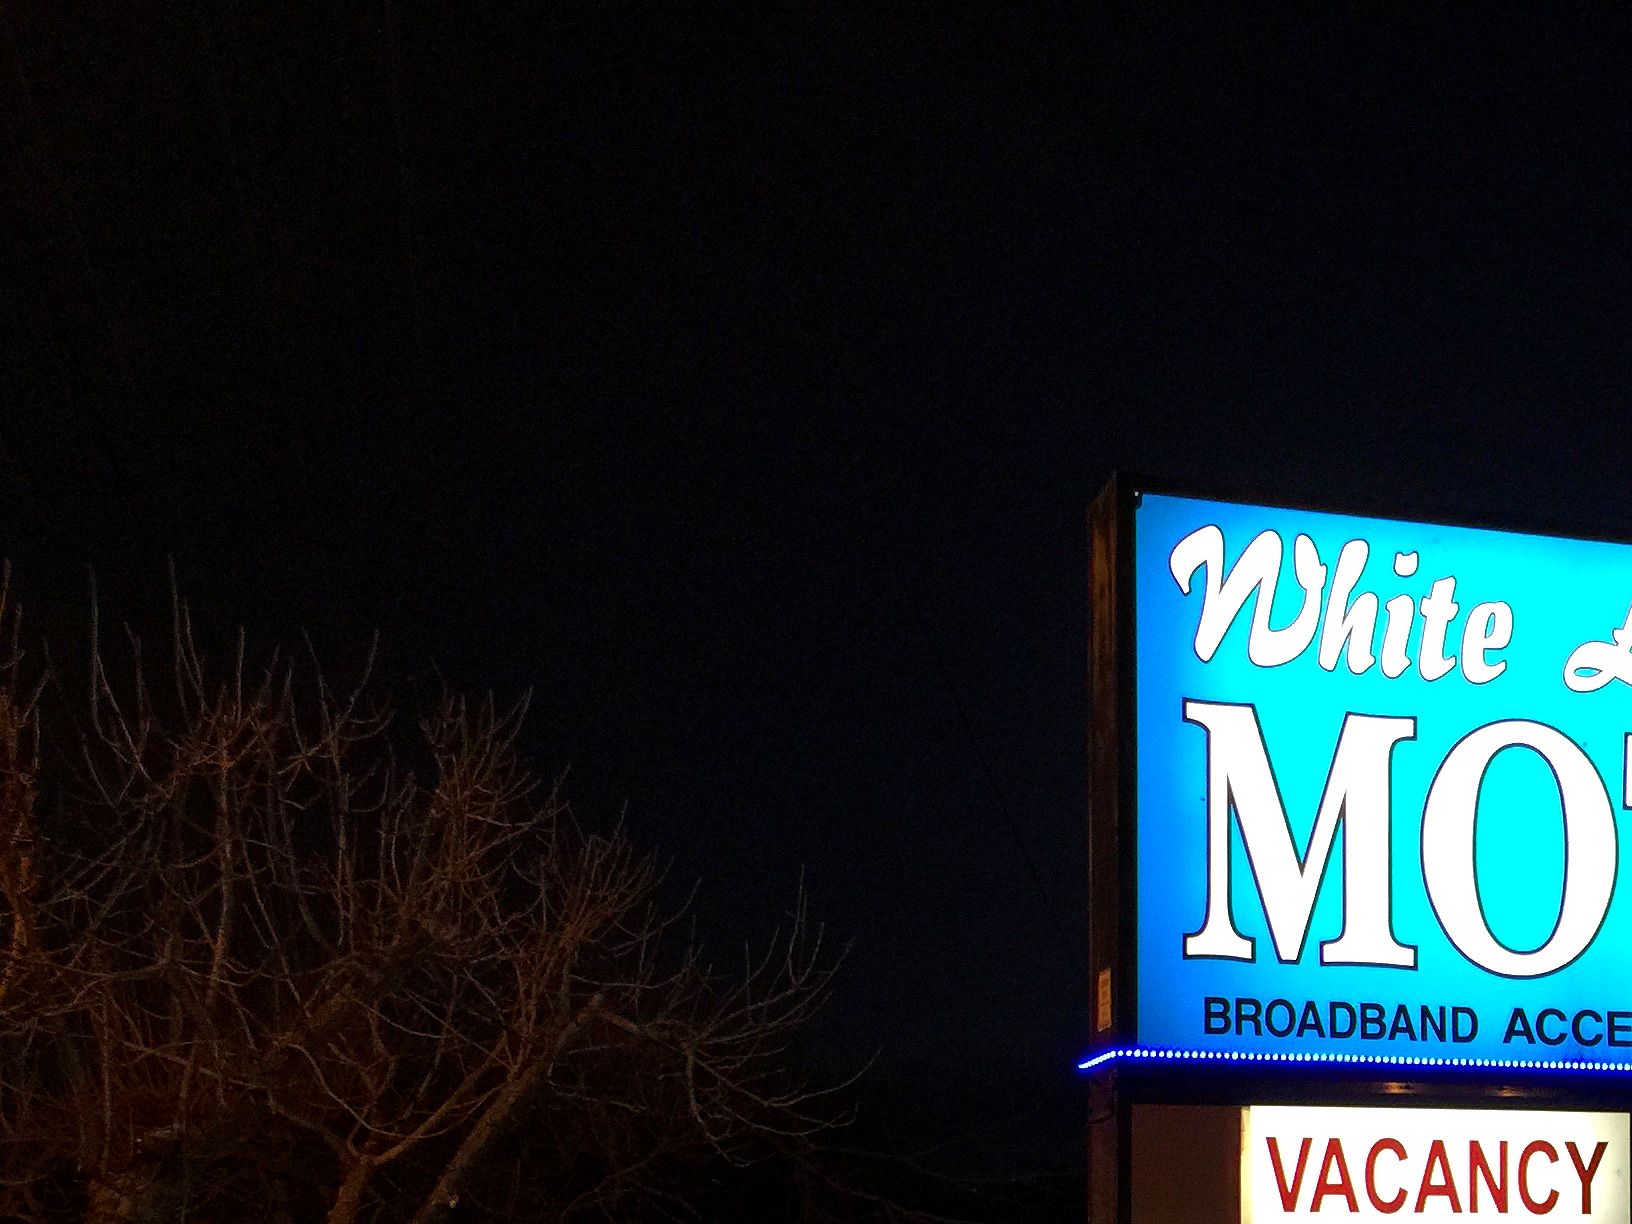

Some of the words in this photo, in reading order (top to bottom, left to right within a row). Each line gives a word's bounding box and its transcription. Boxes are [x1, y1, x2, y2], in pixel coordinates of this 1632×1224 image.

[1169, 523, 1514, 686] White
[1203, 996, 1480, 1046] BROADBAND
[1265, 1136, 1610, 1216] VACANCY
